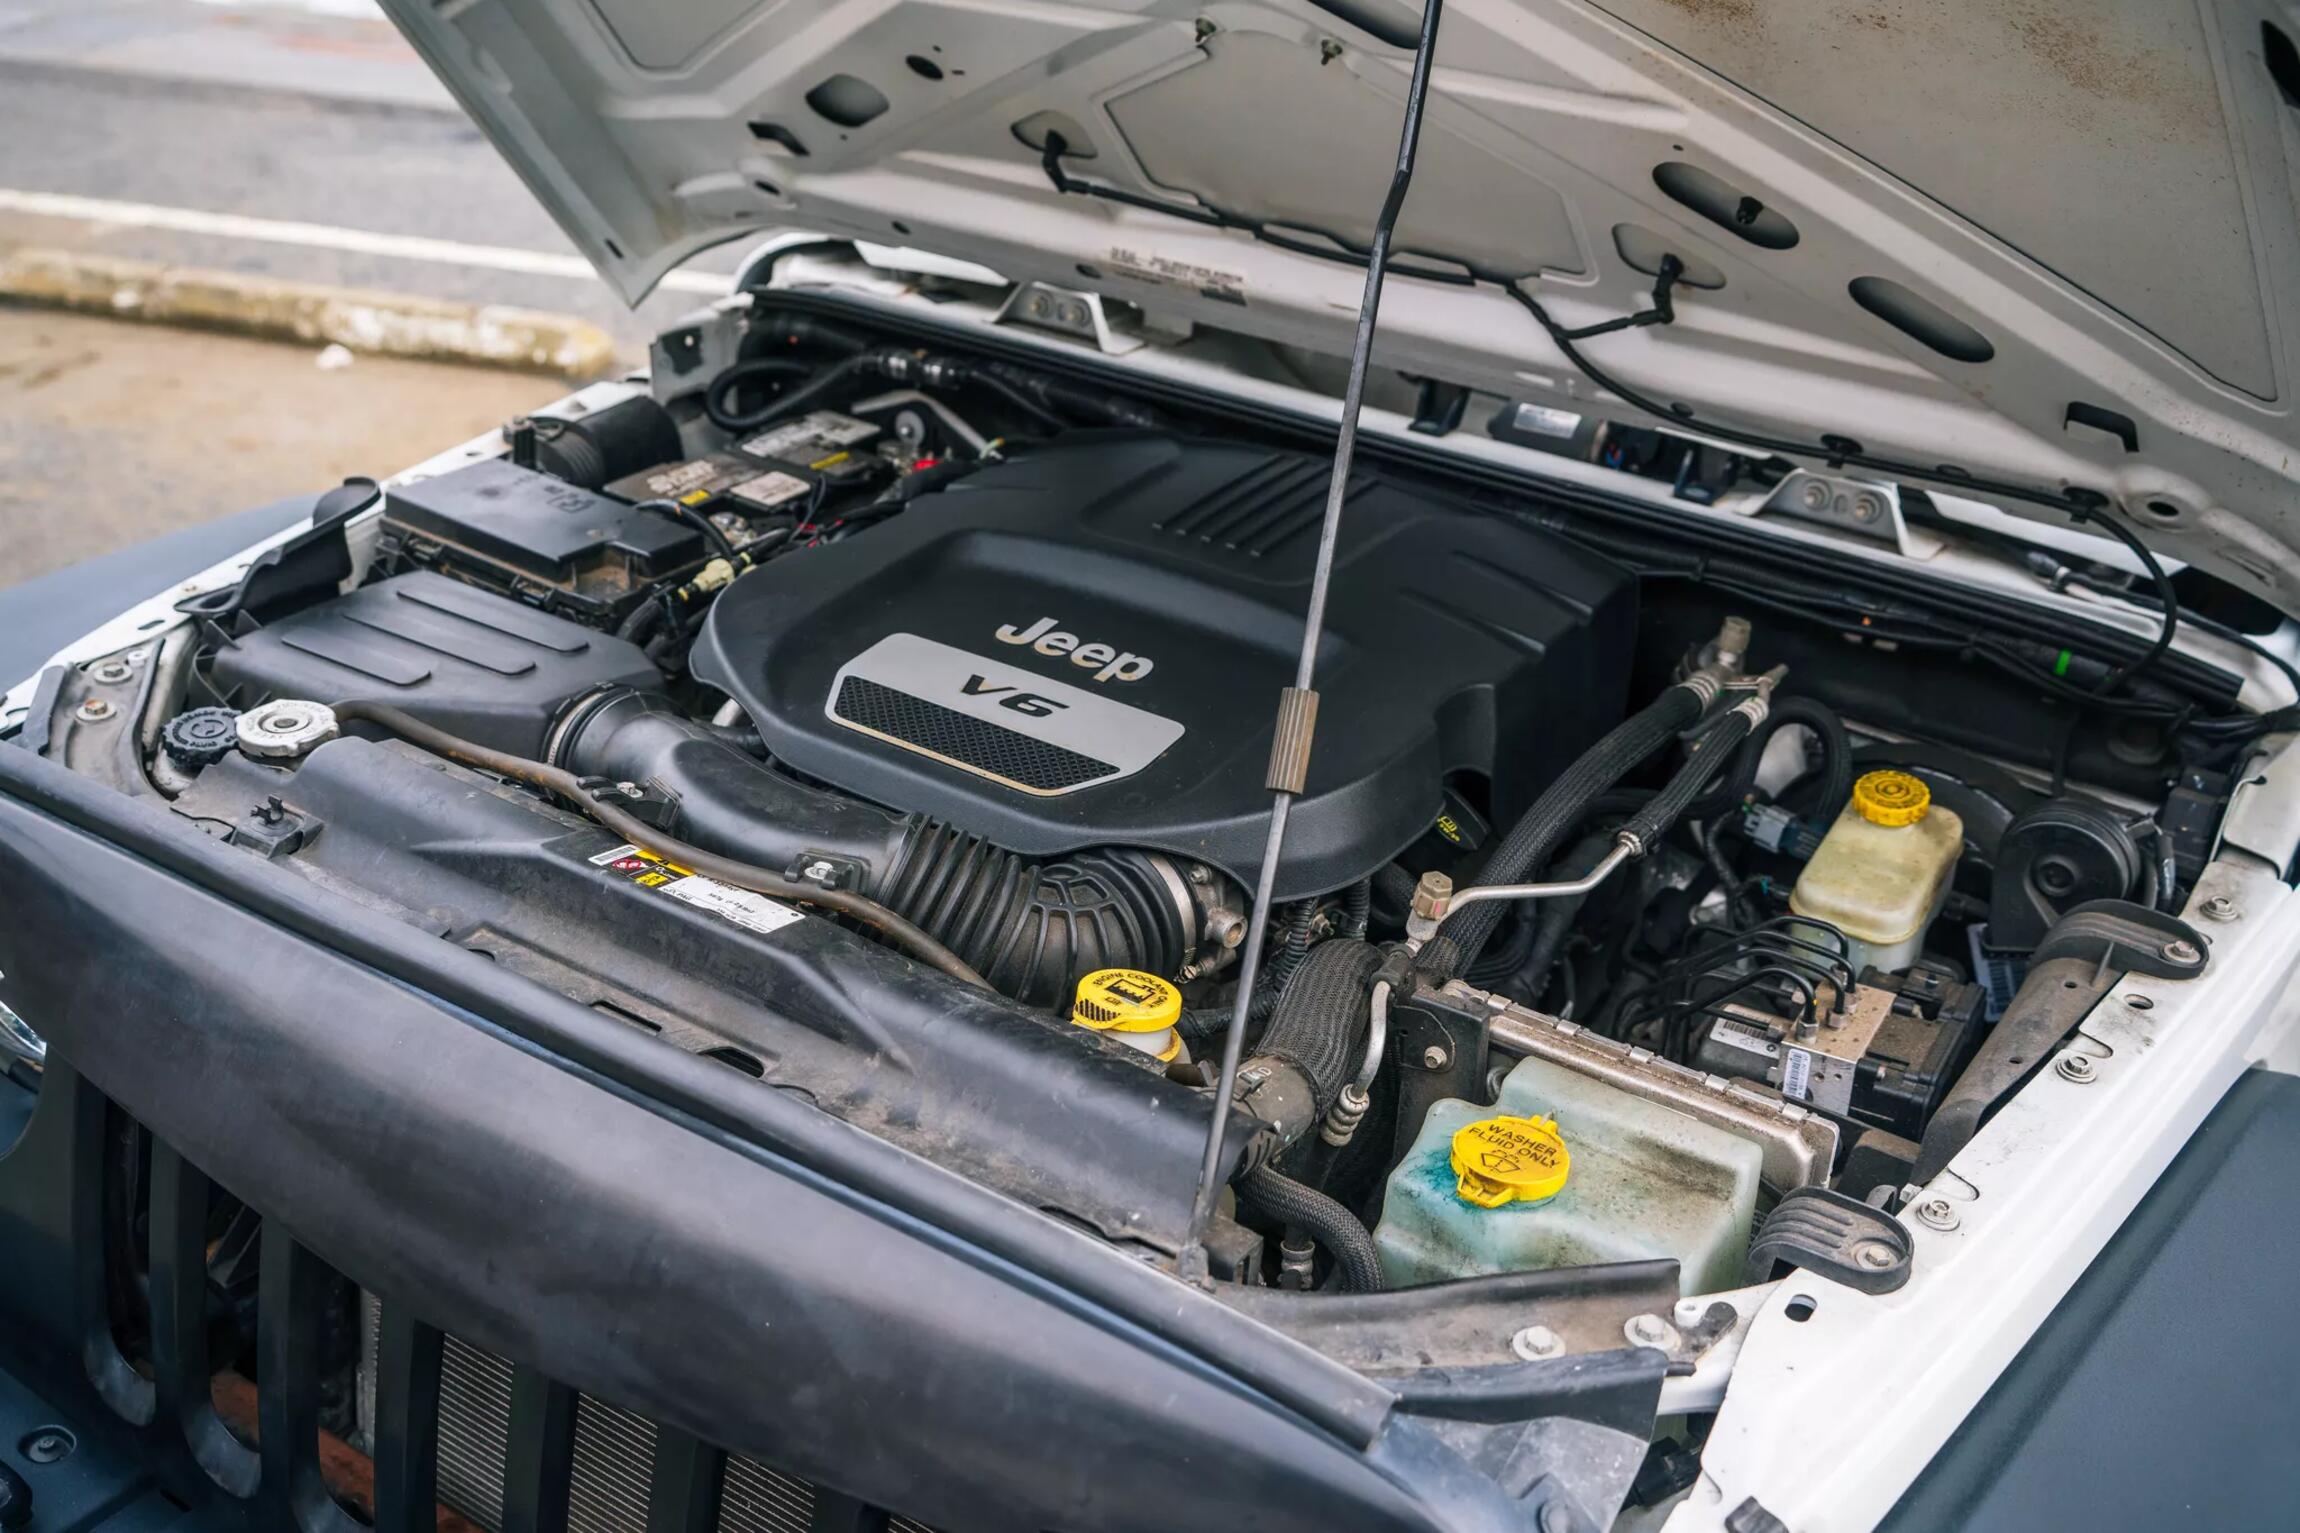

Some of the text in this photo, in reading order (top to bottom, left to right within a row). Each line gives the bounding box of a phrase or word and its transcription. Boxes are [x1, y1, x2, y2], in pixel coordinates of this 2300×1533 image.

[995, 617, 1154, 682] Jeep
[961, 674, 1070, 718] V6
[1093, 972, 1124, 986] ENGINE
[1127, 973, 1168, 996] COOLANT
[1468, 1127, 1561, 1168] FLUID ONLY
[1488, 1124, 1557, 1156] WASHER
